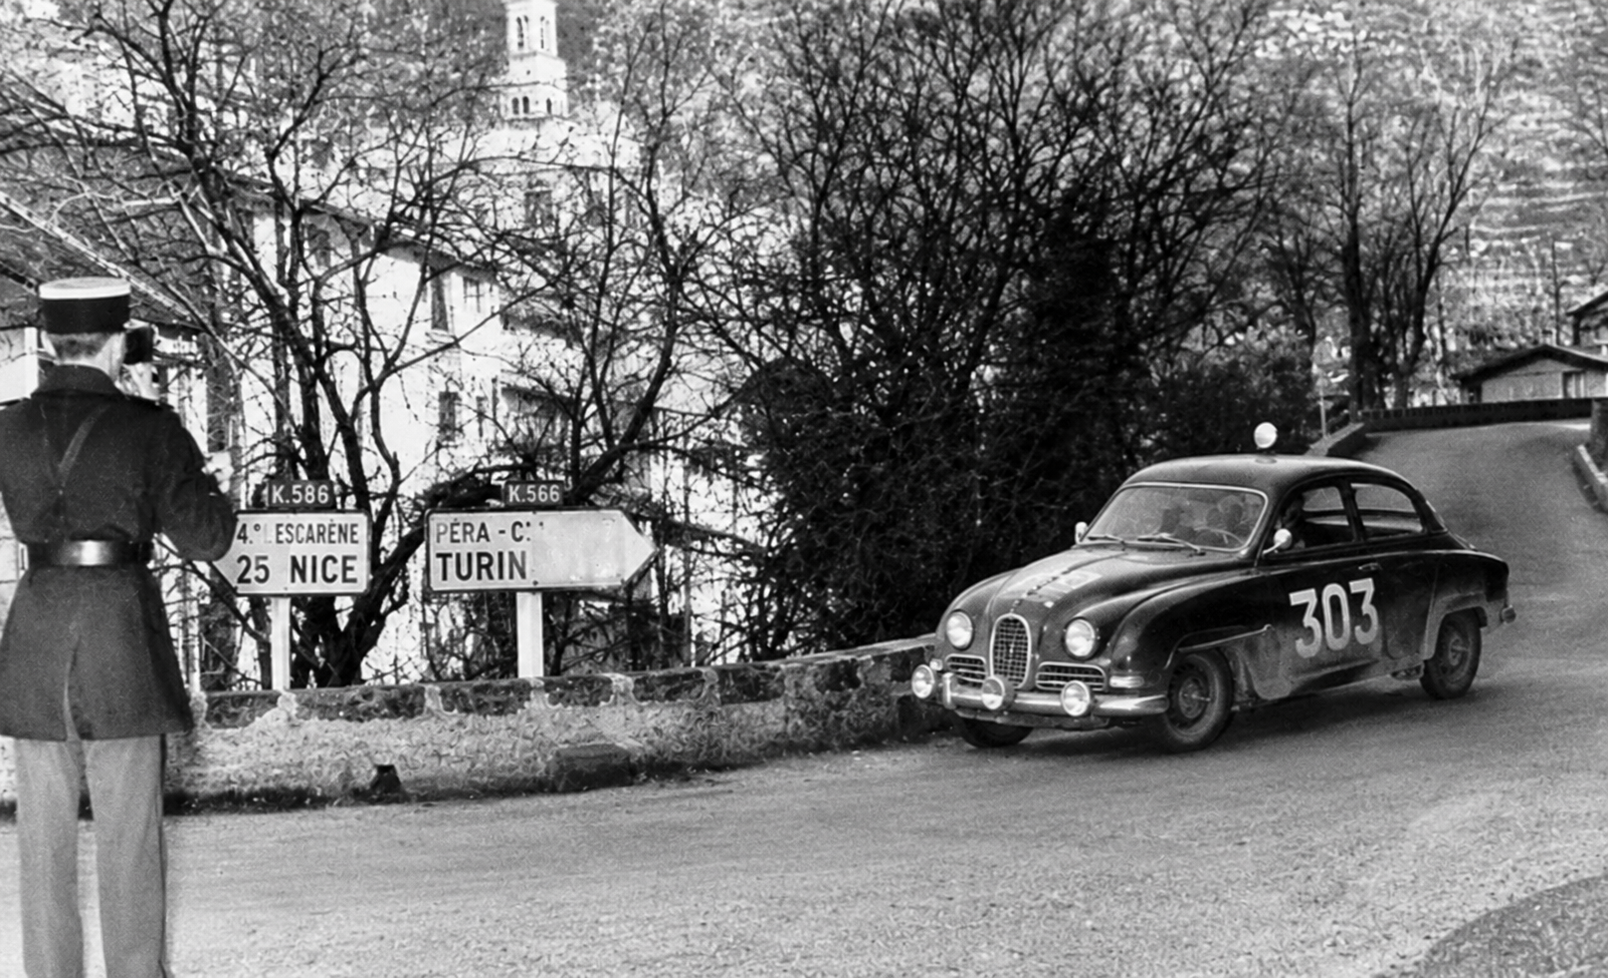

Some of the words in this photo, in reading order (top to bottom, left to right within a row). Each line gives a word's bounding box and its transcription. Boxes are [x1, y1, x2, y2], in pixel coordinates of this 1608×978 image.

[272, 484, 329, 504] K.586
[508, 484, 560, 503] K.566
[236, 554, 270, 584] 25
[290, 554, 358, 584] NICE
[435, 550, 527, 582] TURIN
[1288, 577, 1379, 659] 303
